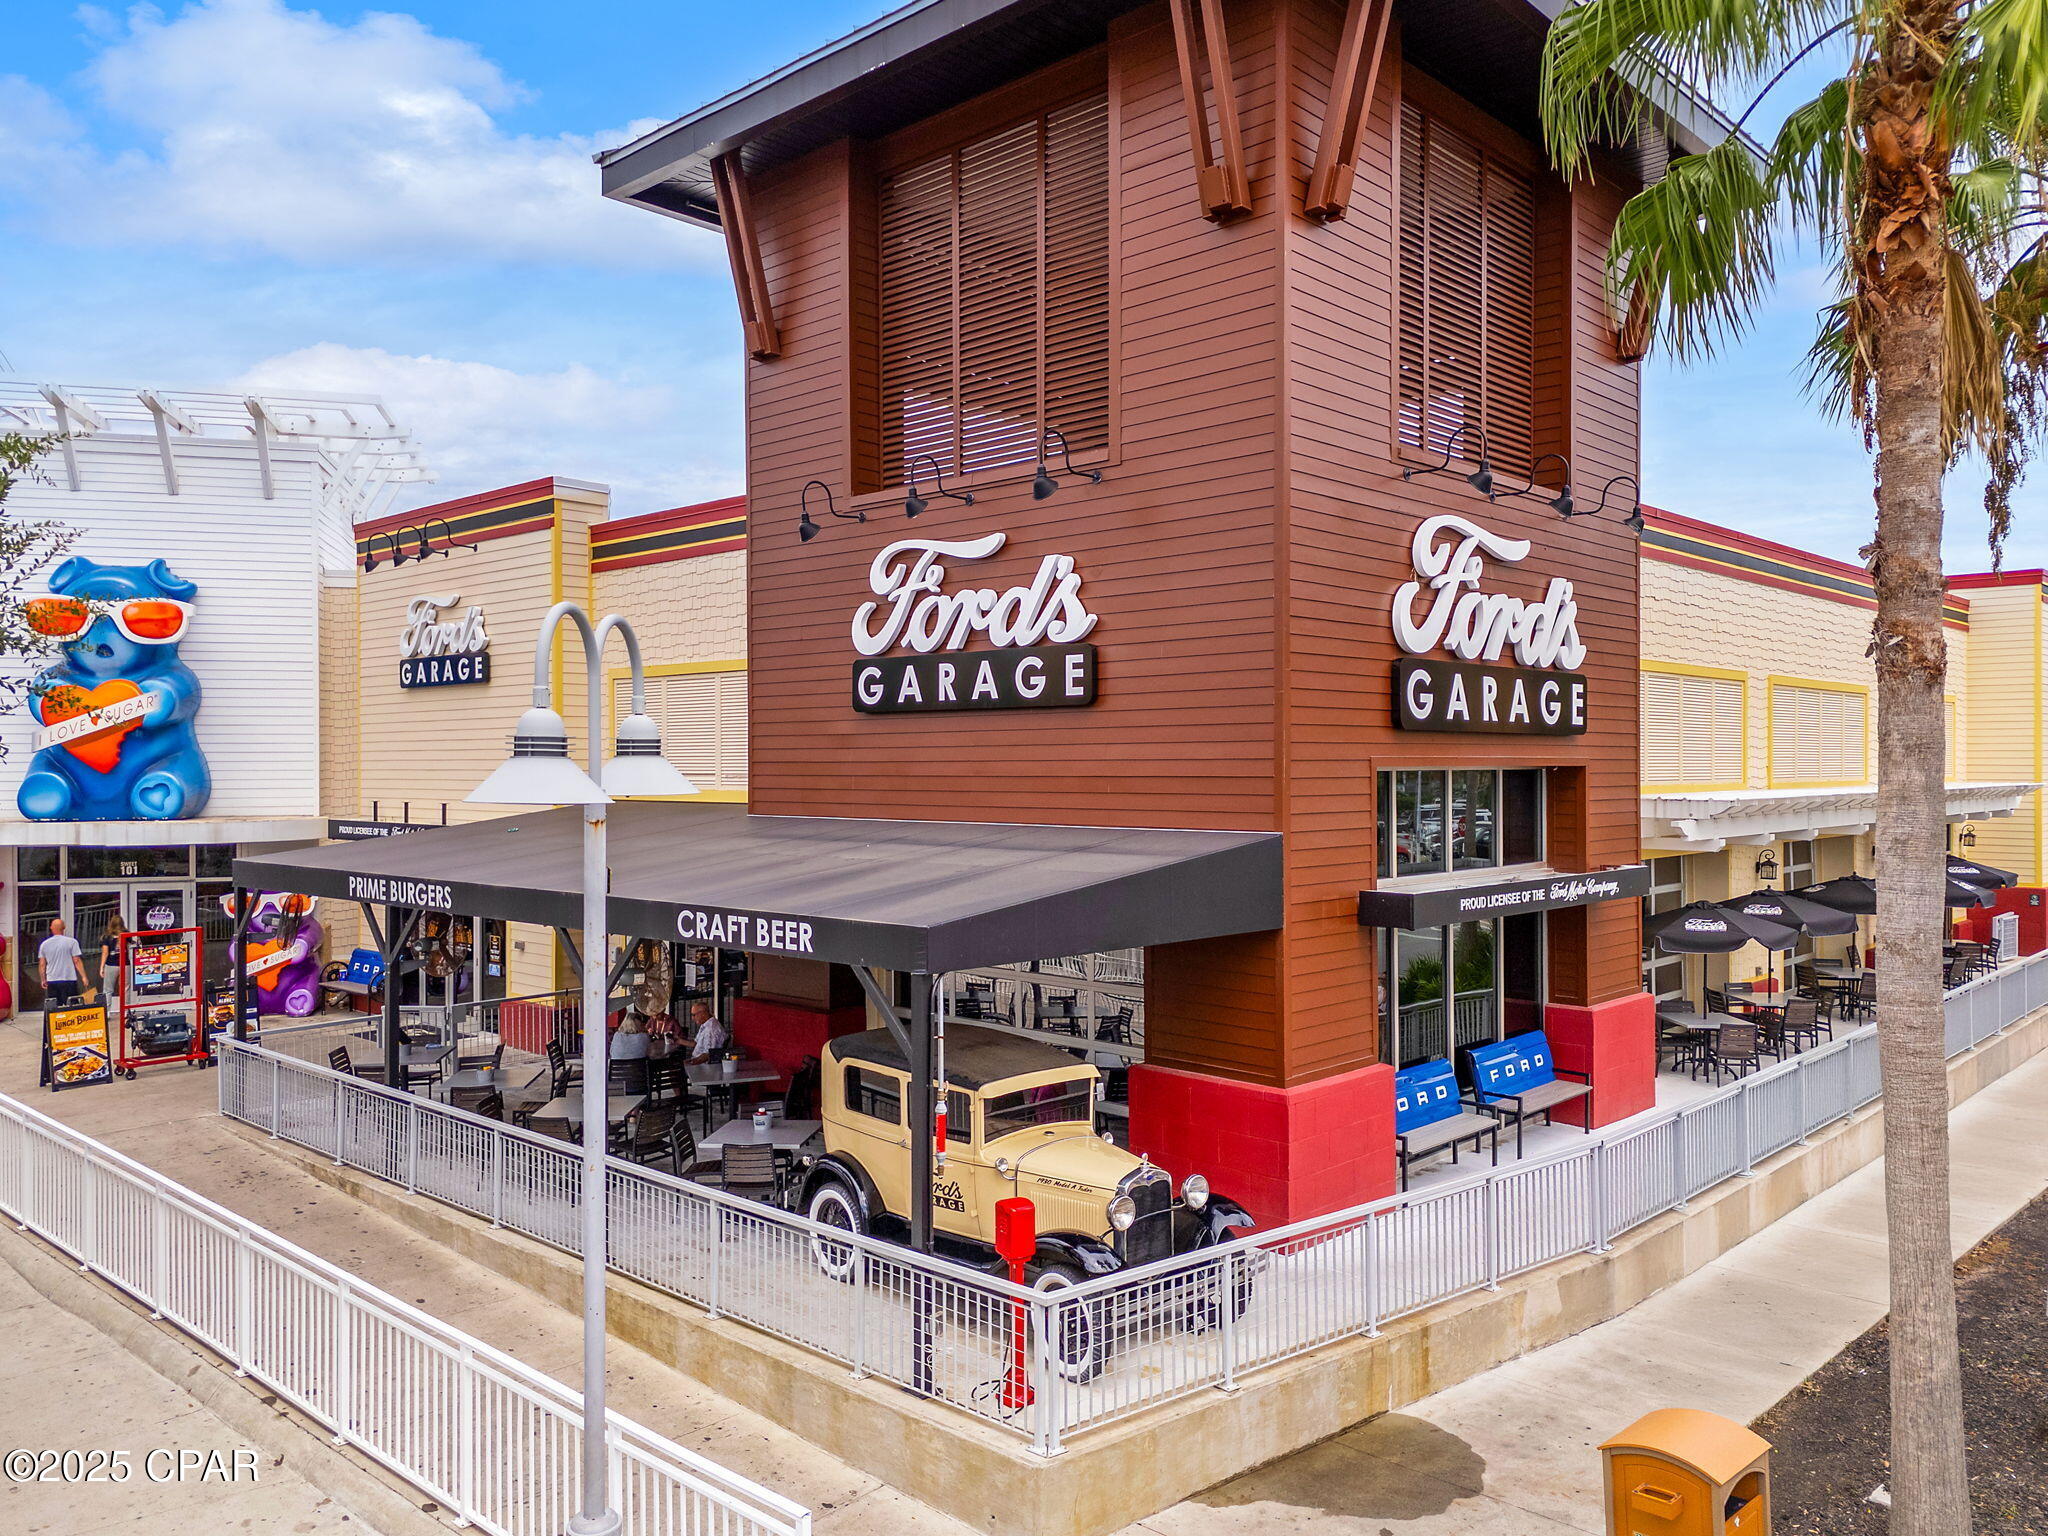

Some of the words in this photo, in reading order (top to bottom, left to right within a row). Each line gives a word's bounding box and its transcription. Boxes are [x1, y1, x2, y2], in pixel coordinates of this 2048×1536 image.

[852, 533, 1098, 656] Ford's
[1392, 515, 1587, 670] Ford's
[400, 594, 490, 657] Ford's
[402, 657, 483, 684] GARAGE
[858, 654, 1084, 705] GARAGE
[1407, 669, 1584, 725] GARAGE
[49, 718, 86, 743] LOVE
[338, 826, 352, 834] PROUD
[121, 866, 138, 875] 101
[349, 876, 387, 901] PRIME
[390, 880, 452, 909] BURGERS
[1460, 896, 1487, 911] PROUD
[1487, 892, 1521, 908] LICENSEE
[1521, 890, 1532, 903] OF
[1532, 888, 1546, 901] THE
[1550, 882, 1569, 900] Ford
[1564, 880, 1587, 901] Motor
[1586, 878, 1620, 898] Company
[677, 910, 749, 945] CRAFT
[756, 918, 814, 952] BEER
[270, 947, 299, 963] SUGAR
[1490, 1053, 1544, 1083] FORD
[1396, 1085, 1448, 1112] ORD
[1053, 1180, 1071, 1189] Model
[932, 1196, 964, 1211] RAGE
